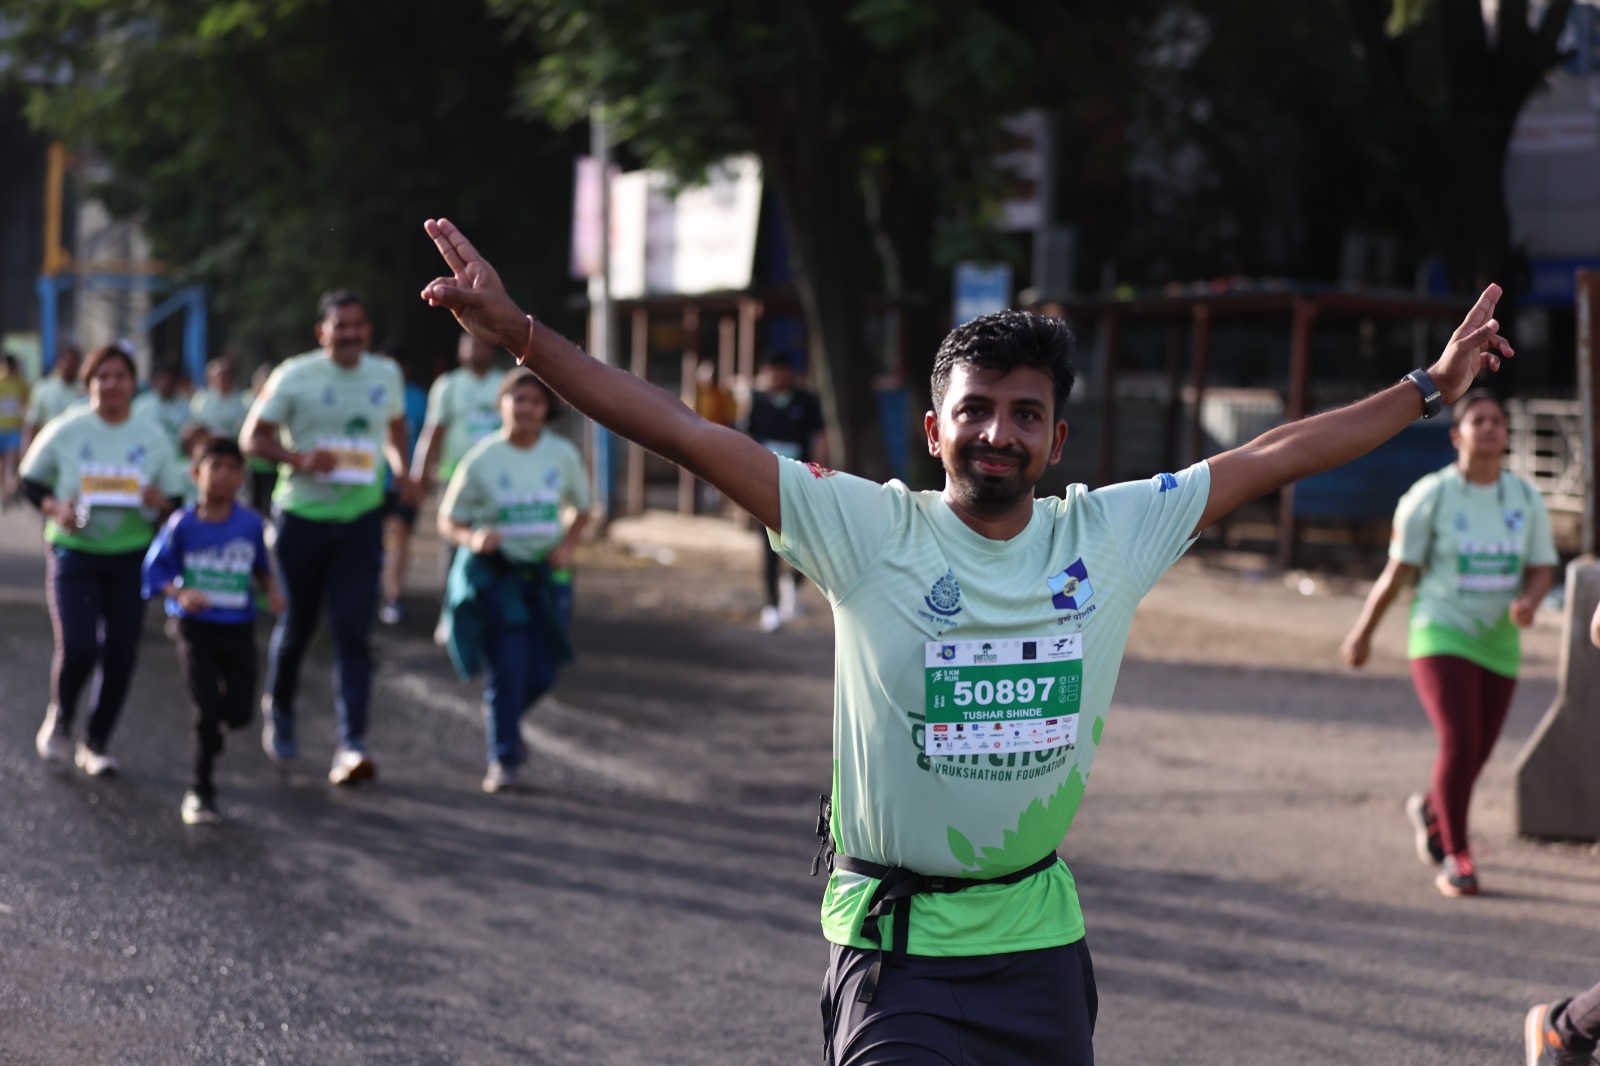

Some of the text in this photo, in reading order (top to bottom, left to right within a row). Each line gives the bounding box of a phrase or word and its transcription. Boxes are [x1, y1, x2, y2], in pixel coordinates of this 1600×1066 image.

[953, 676, 1056, 706] 50897
[962, 707, 1043, 721] TUSHAR SHINDE
[935, 763, 1012, 782] VRUKSHATHON
[1016, 755, 1067, 781] FOUNDATION
